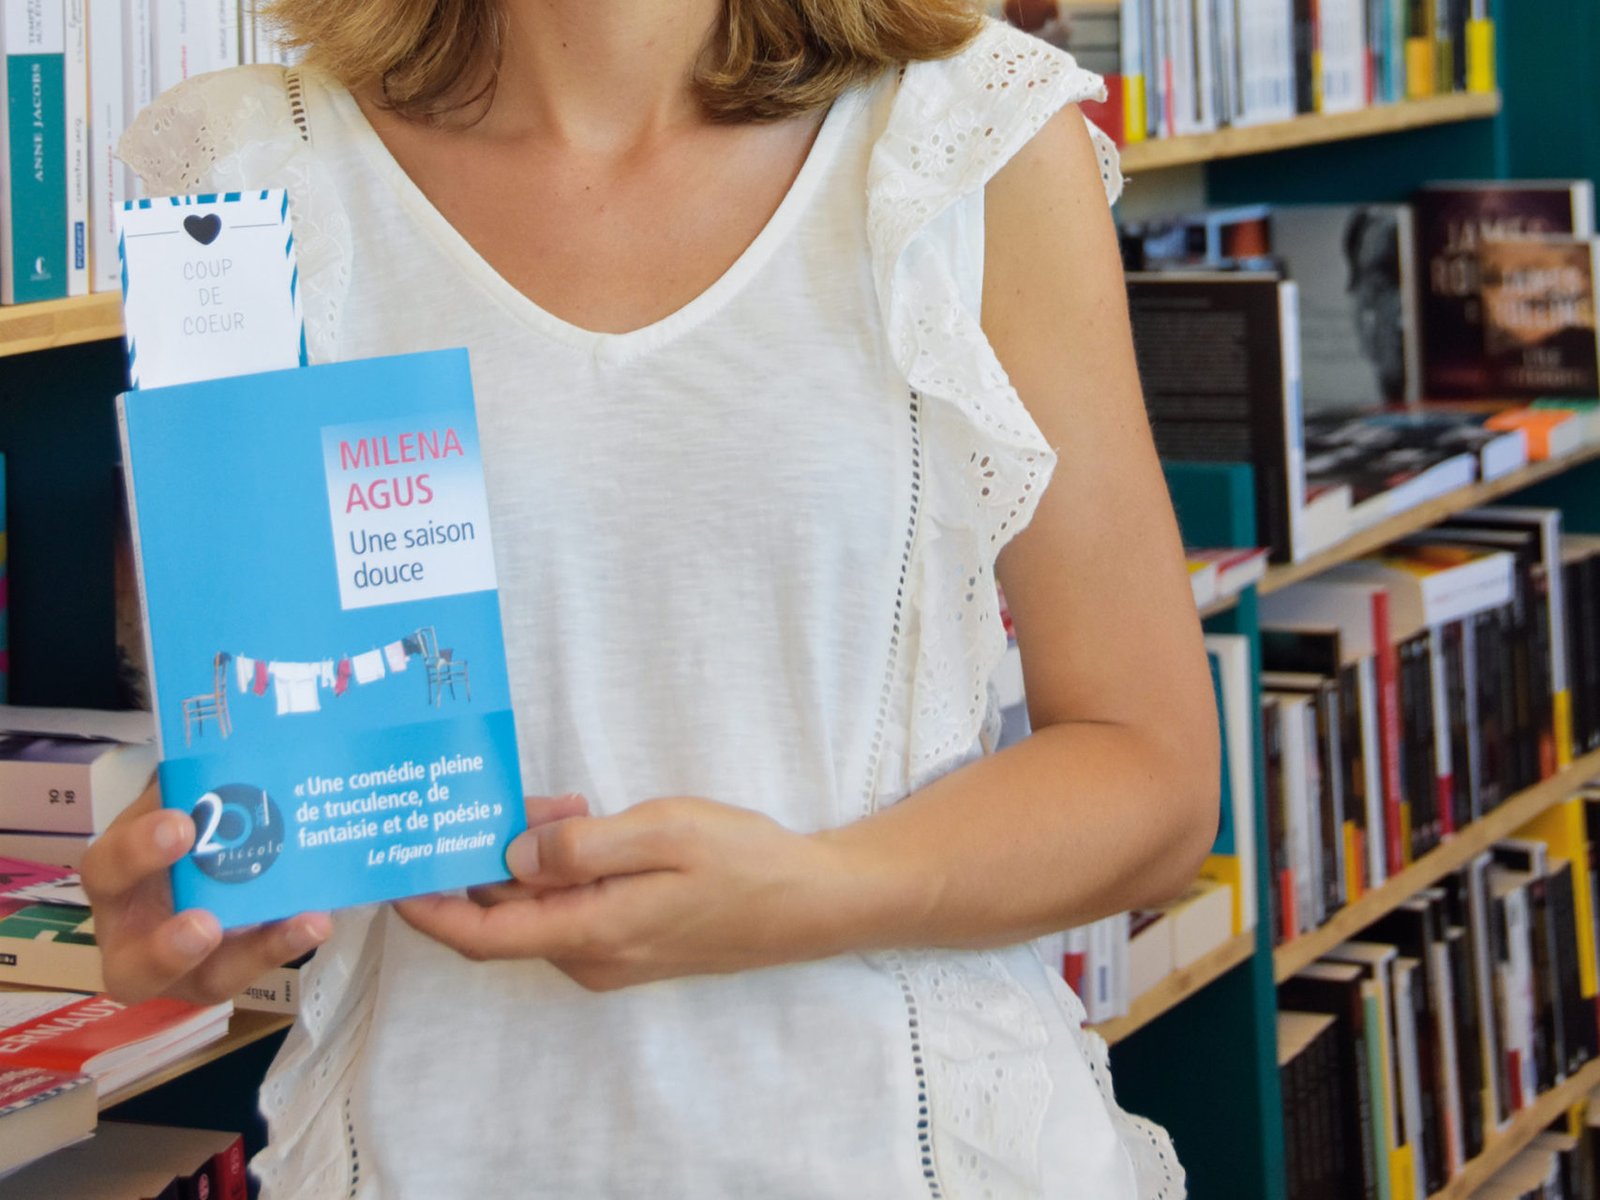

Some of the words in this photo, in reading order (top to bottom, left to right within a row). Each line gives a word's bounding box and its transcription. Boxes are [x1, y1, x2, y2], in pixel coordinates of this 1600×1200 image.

[31, 63, 44, 128] JACOBS
[33, 132, 44, 183] ANNE
[75, 223, 83, 268] POCKET
[183, 258, 232, 280] COUP
[199, 286, 223, 306] DE
[183, 312, 244, 335] COEUR
[339, 427, 464, 470] MILENA
[345, 474, 433, 514] AGUS
[350, 529, 397, 555] Une
[404, 520, 475, 548] saison
[353, 561, 424, 589] douce
[307, 776, 343, 796] Une
[349, 761, 425, 789] comédie
[430, 754, 484, 781] pleine
[296, 802, 319, 823] de
[324, 791, 423, 818] truculence,
[427, 783, 449, 802] de
[298, 818, 378, 847] fantaisie
[383, 818, 401, 834] et
[406, 810, 428, 831] de
[433, 801, 490, 829] poésie
[217, 840, 284, 867] piccolo
[367, 850, 385, 866] Le
[388, 842, 433, 864] Figaro
[436, 831, 496, 854] littéraire
[0, 998, 127, 1054] ERNAUX
